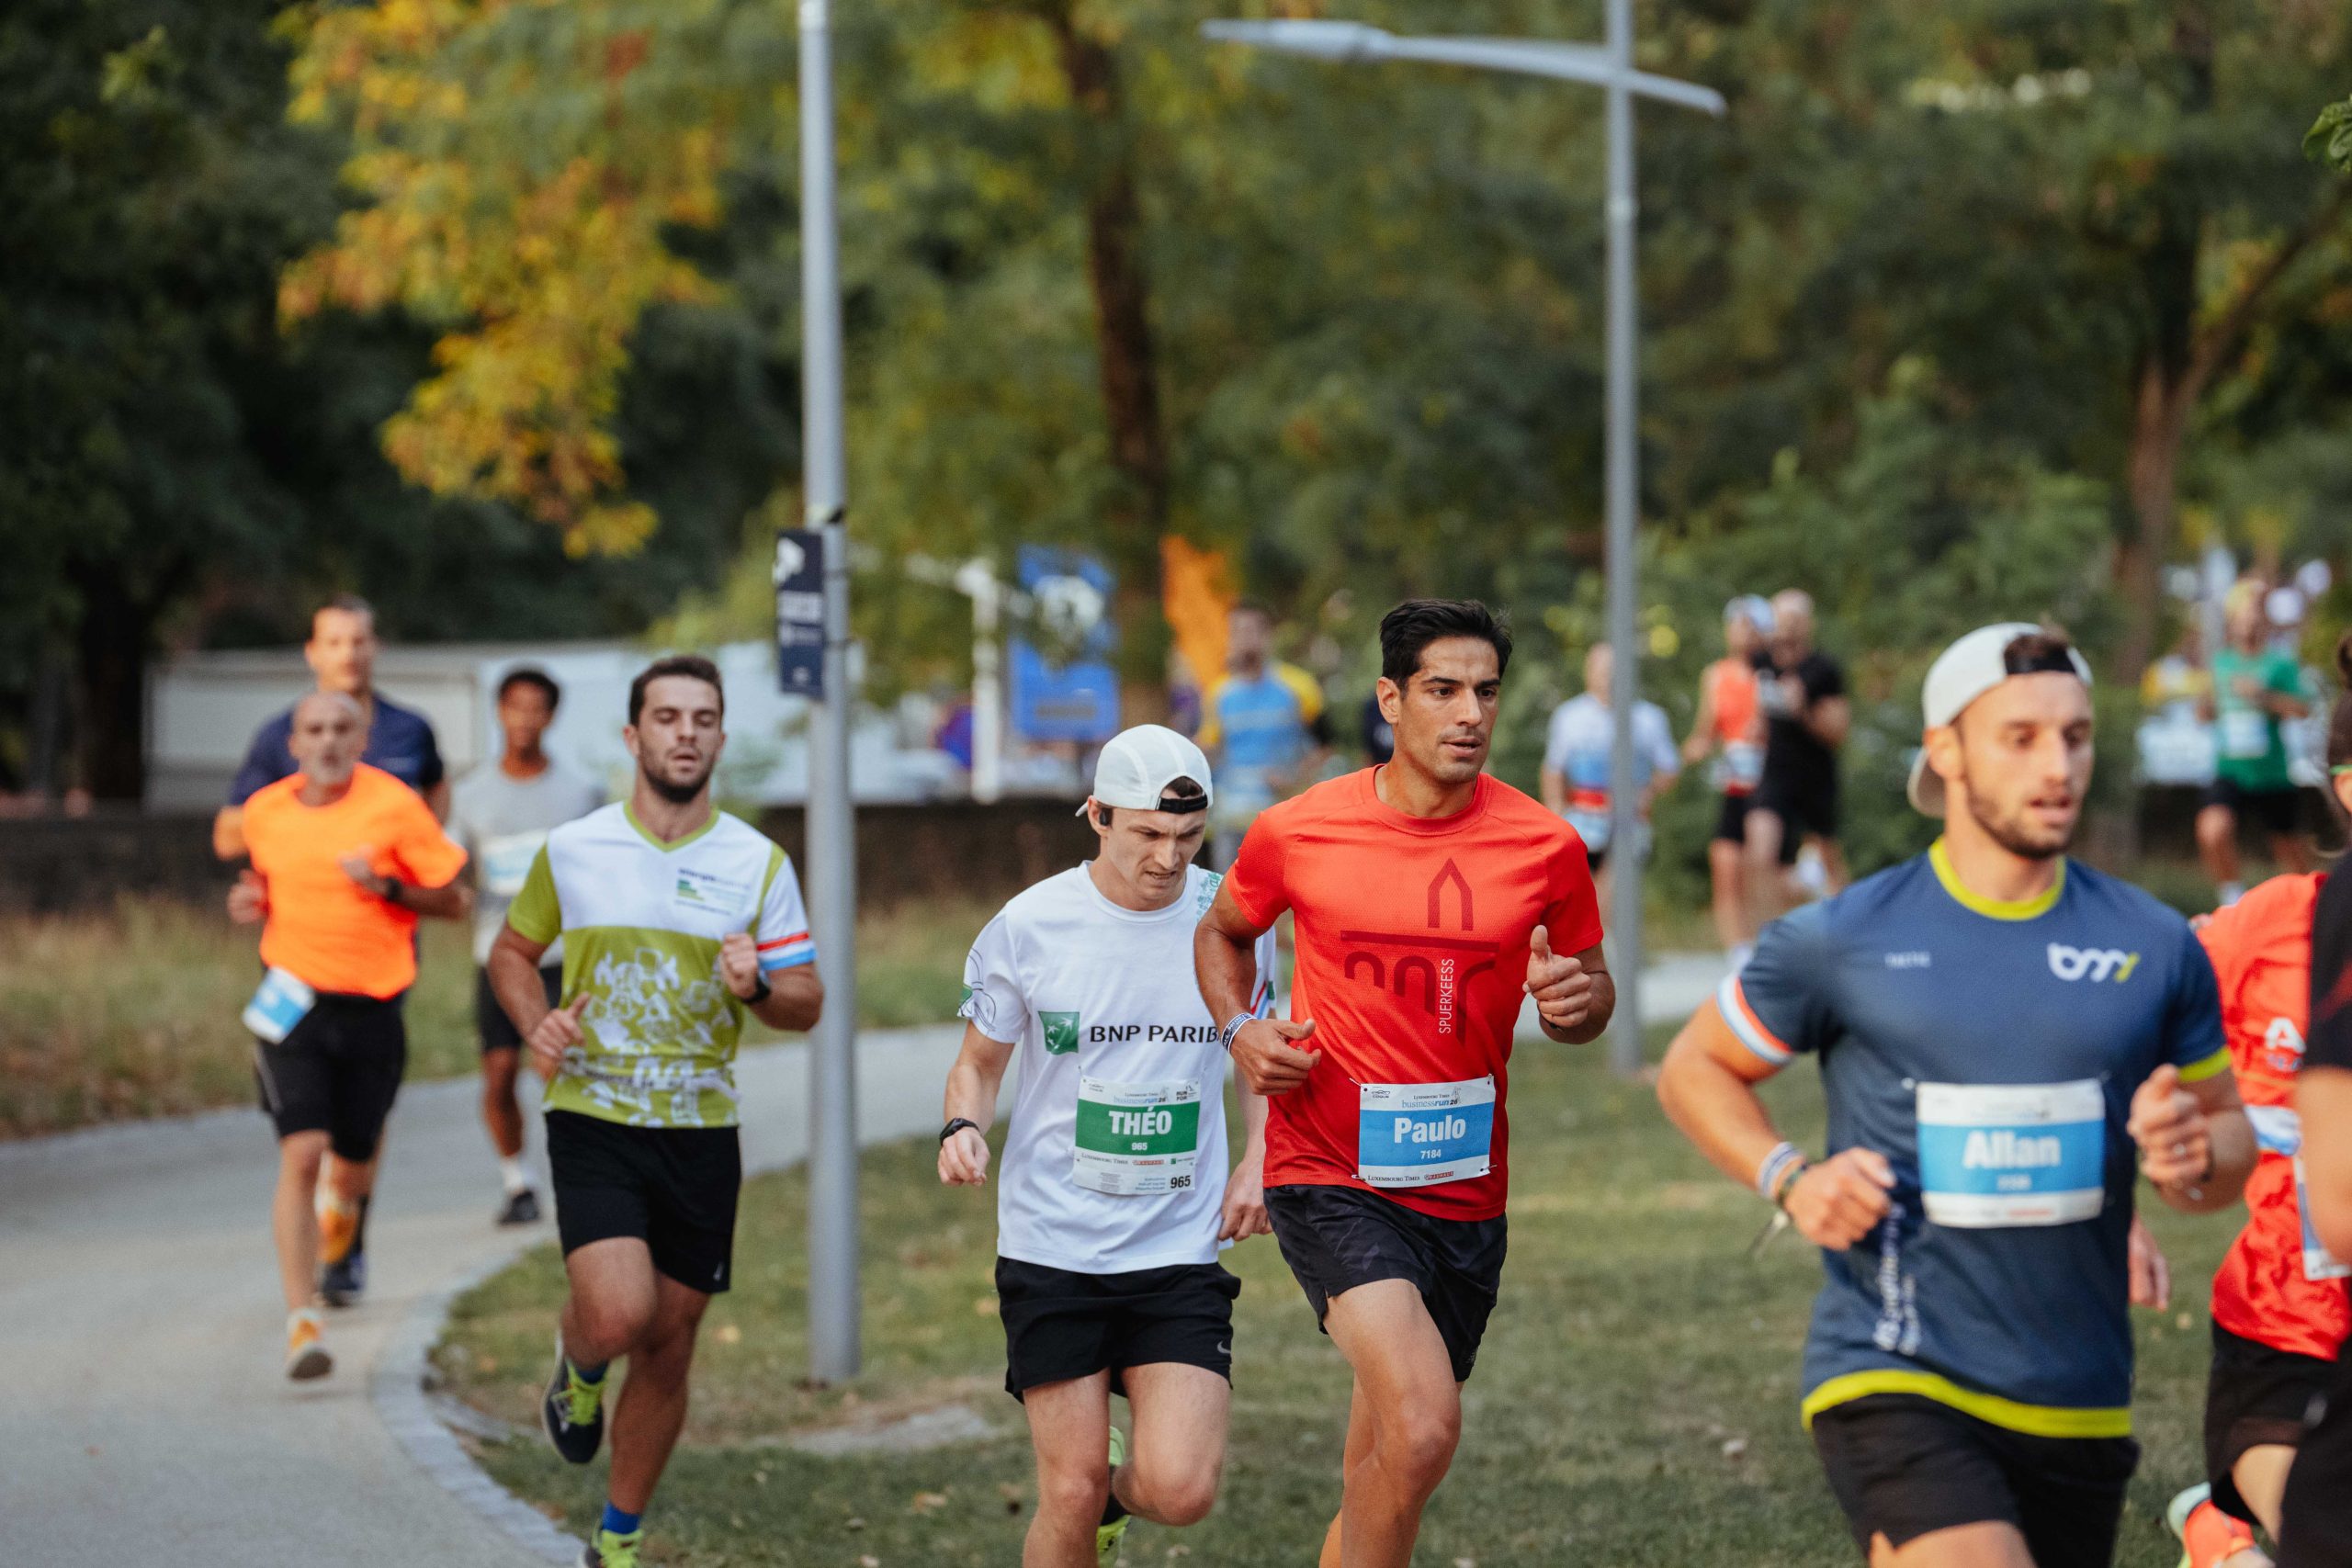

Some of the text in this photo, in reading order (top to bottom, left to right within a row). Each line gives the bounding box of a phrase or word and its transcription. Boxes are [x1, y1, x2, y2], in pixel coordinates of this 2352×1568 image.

[1439, 958, 1454, 1034] SPUERKEESS
[1090, 1025, 1141, 1043] BNP
[1148, 1025, 1220, 1043] PARIB
[1108, 1106, 1172, 1135] THÉO
[1394, 1115, 1466, 1144] Paulo
[1131, 1142, 1148, 1151] 965
[1420, 1149, 1442, 1159] 7184
[1963, 1131, 2061, 1168] Allan
[1170, 1175, 1191, 1189] 965
